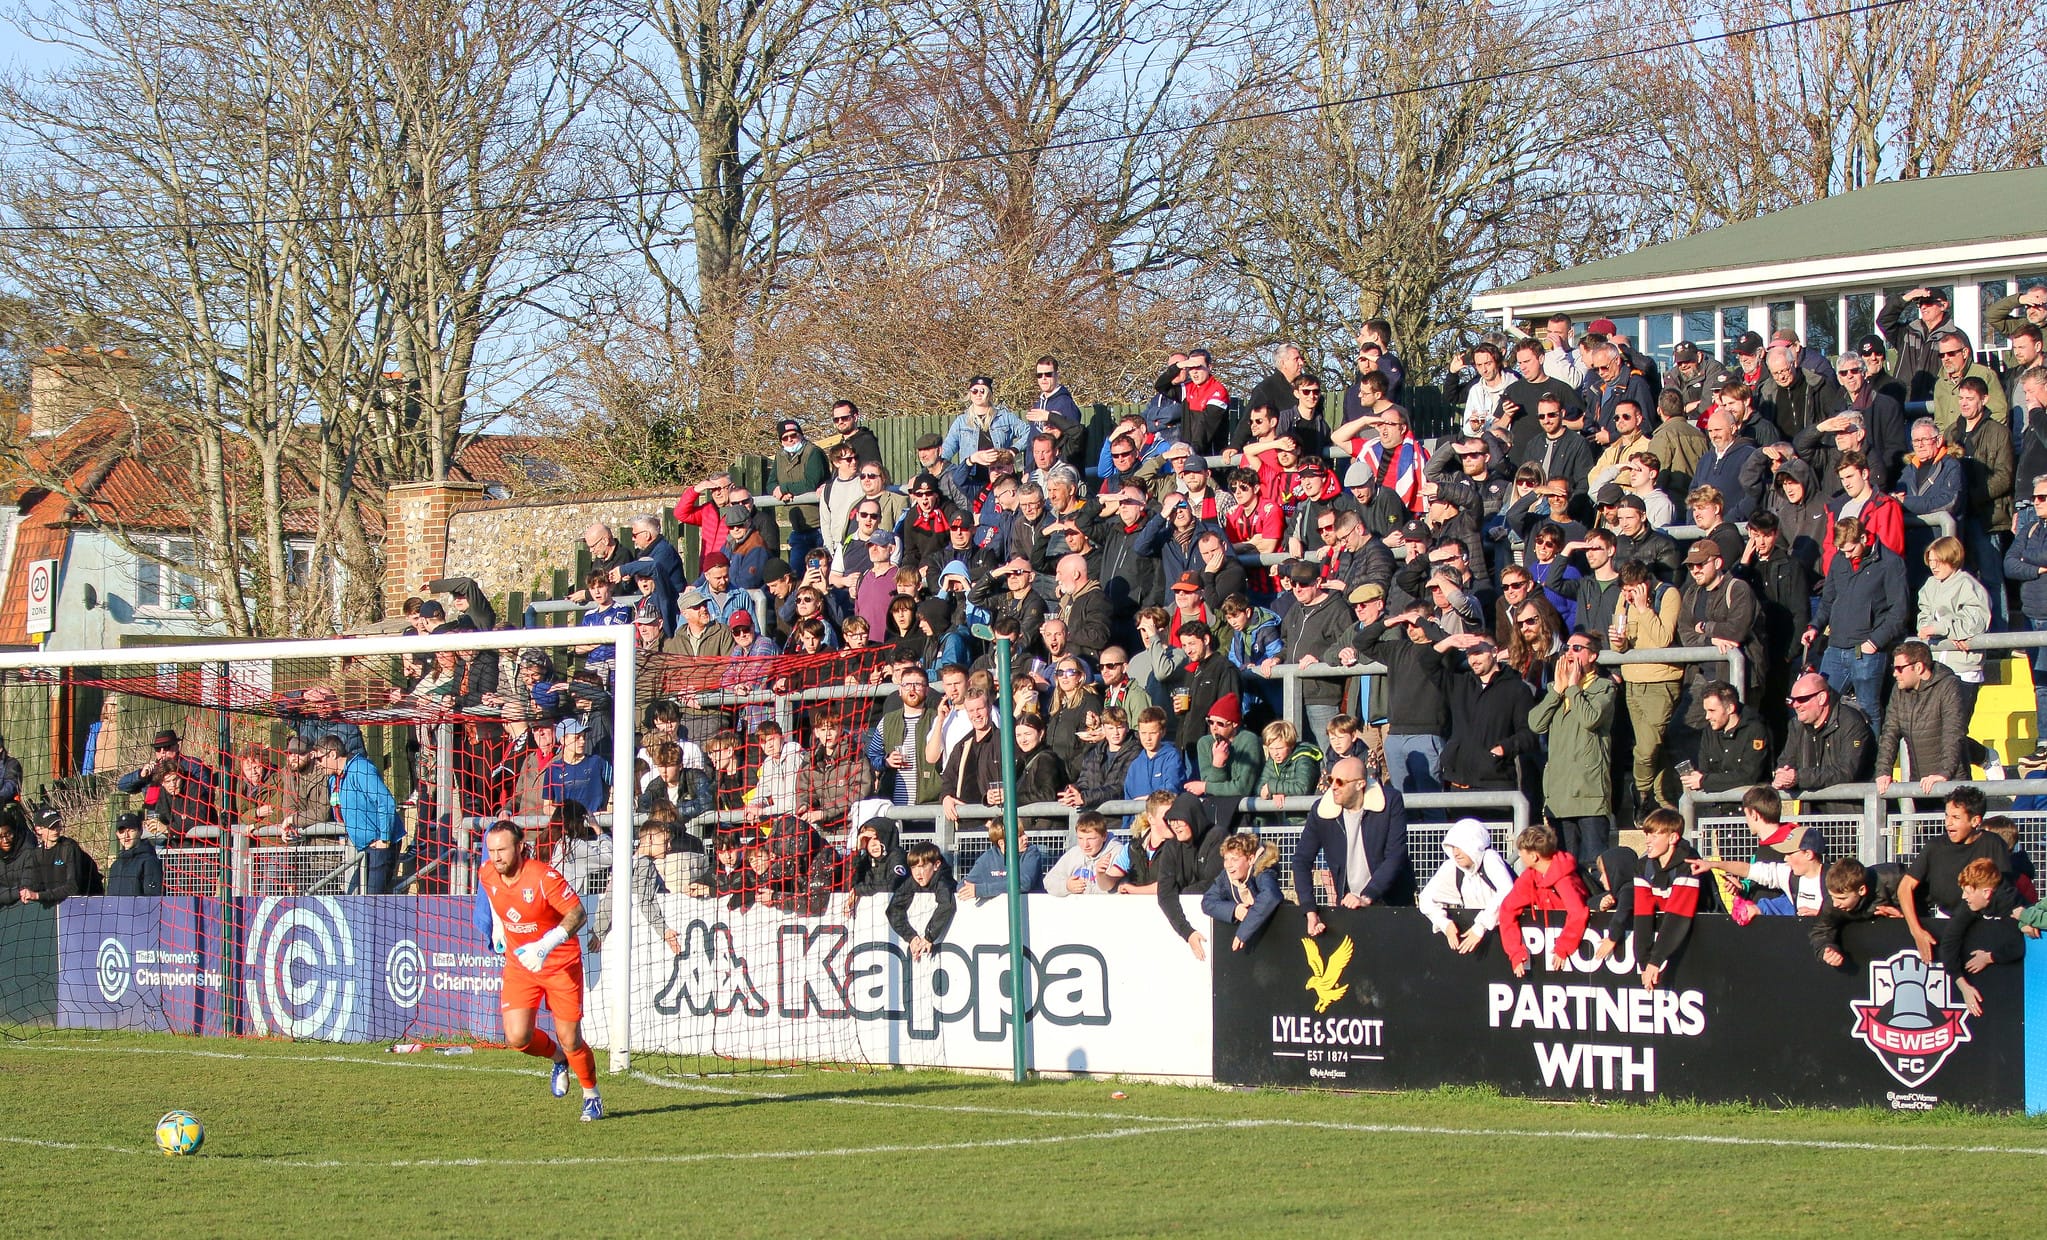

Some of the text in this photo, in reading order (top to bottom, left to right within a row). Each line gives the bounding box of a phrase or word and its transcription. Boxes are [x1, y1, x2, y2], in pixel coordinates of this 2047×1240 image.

[34, 576, 46, 592] 20
[32, 606, 47, 616] ZONE
[156, 950, 200, 964] Women's
[135, 968, 223, 991] Championship
[777, 924, 1112, 1042] Kappa
[1488, 983, 1706, 1036] PARTNERS
[1872, 1023, 1949, 1050] LEWES
[1307, 1050, 1348, 1063] EST 1874
[1897, 1057, 1925, 1074] FC
[1533, 1042, 1656, 1092] WITH
